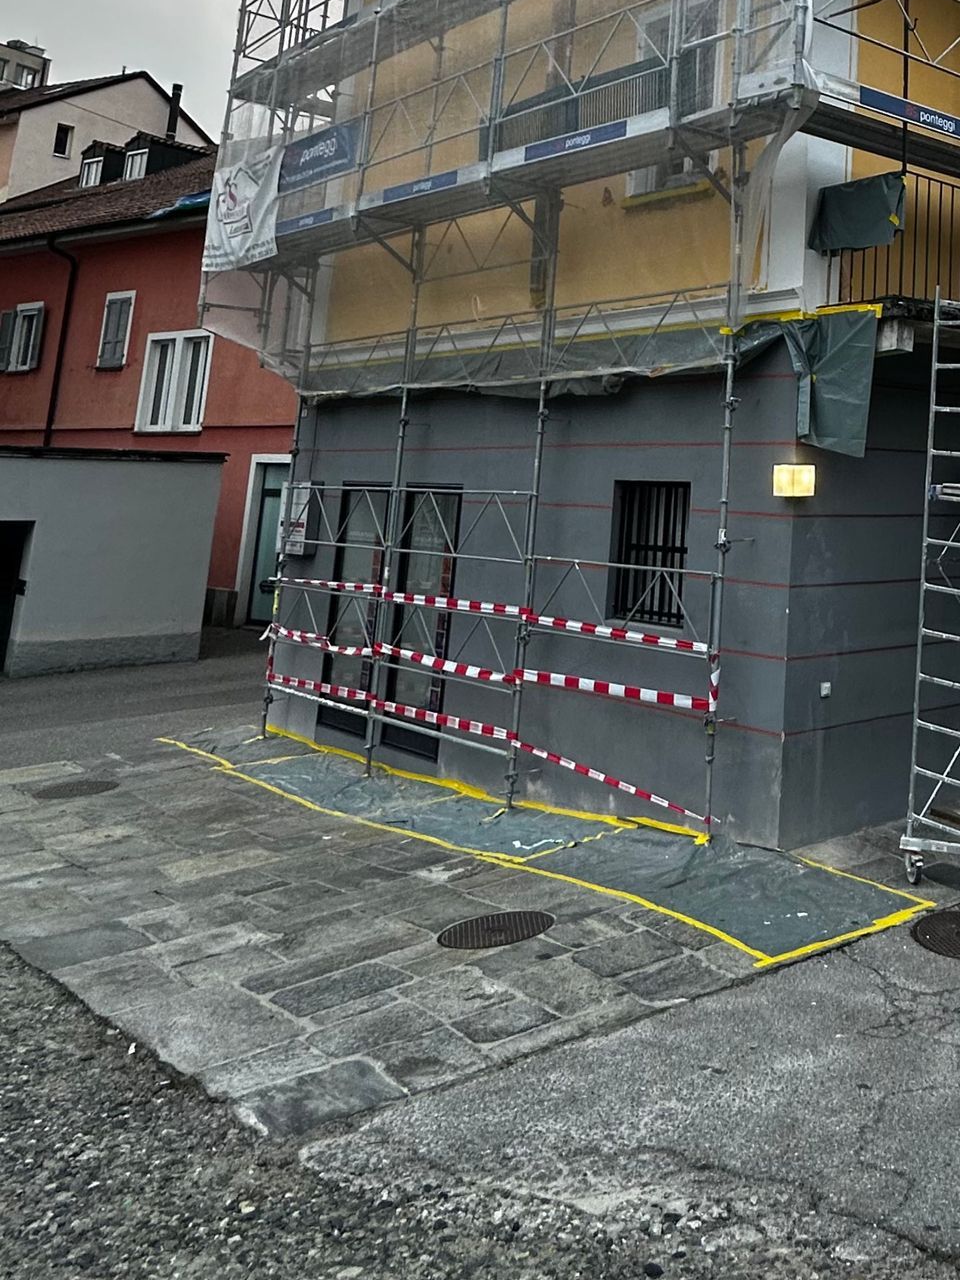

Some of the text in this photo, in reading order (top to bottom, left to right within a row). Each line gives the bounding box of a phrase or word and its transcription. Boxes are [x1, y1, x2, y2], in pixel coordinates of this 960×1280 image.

[919, 111, 956, 133] ponteggi
[300, 132, 338, 166] ponteggi
[565, 131, 592, 149] ponteggi
